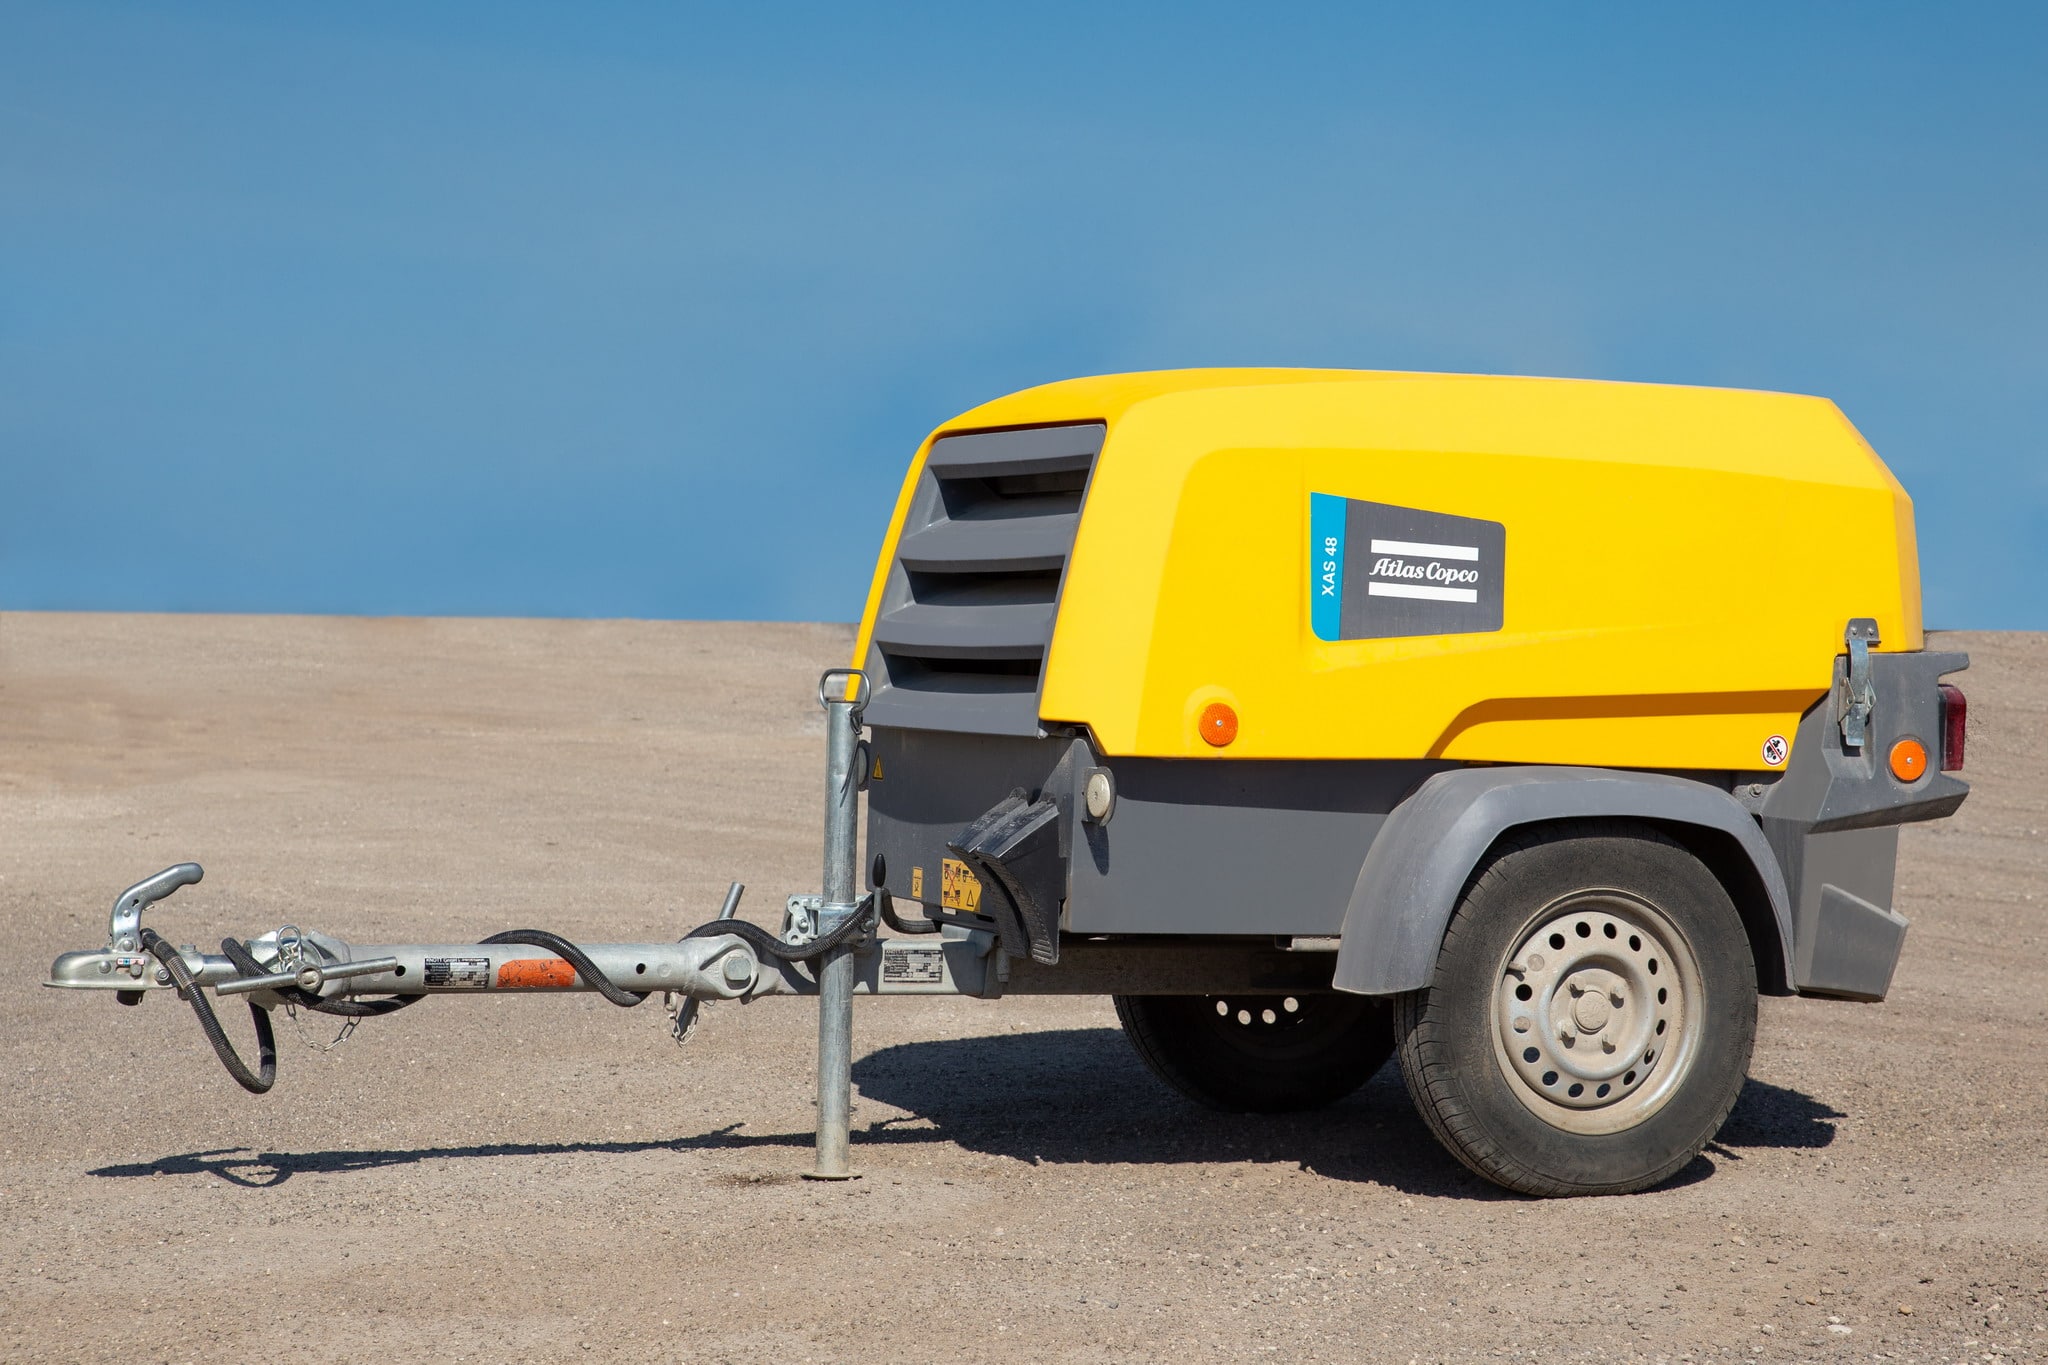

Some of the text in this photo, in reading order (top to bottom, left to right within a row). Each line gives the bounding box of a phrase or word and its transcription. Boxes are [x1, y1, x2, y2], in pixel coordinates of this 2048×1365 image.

[1321, 537, 1338, 597] XAS 48
[1369, 558, 1478, 584] Atlas Copco
